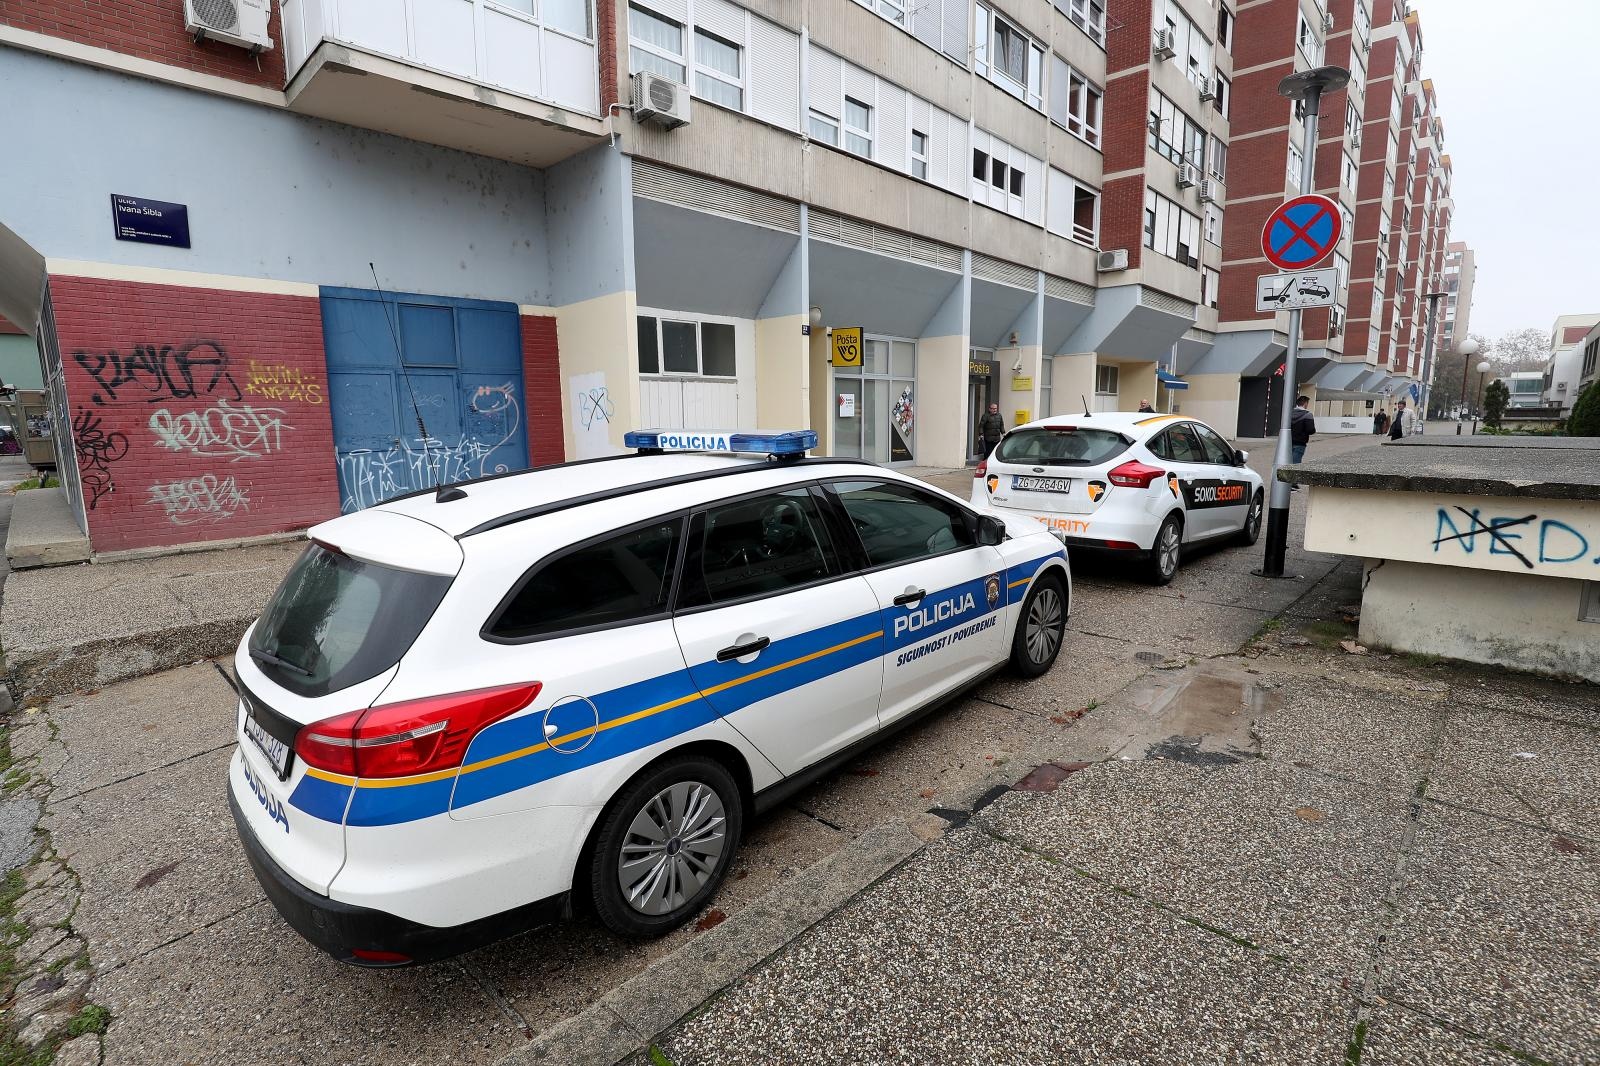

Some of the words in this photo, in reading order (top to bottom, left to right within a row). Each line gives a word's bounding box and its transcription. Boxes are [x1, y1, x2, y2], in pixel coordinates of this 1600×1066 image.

[119, 205, 141, 214] Ivana
[142, 206, 162, 217] Šibla
[836, 334, 857, 344] Pošta
[969, 361, 990, 374] Pošta
[660, 435, 727, 450] POLICIJA
[1018, 477, 1029, 488] ZG
[894, 592, 975, 638] POLICIJA
[897, 637, 948, 667] SIGURNOST
[947, 634, 953, 645] I
[952, 615, 997, 643] POVJERENJE
